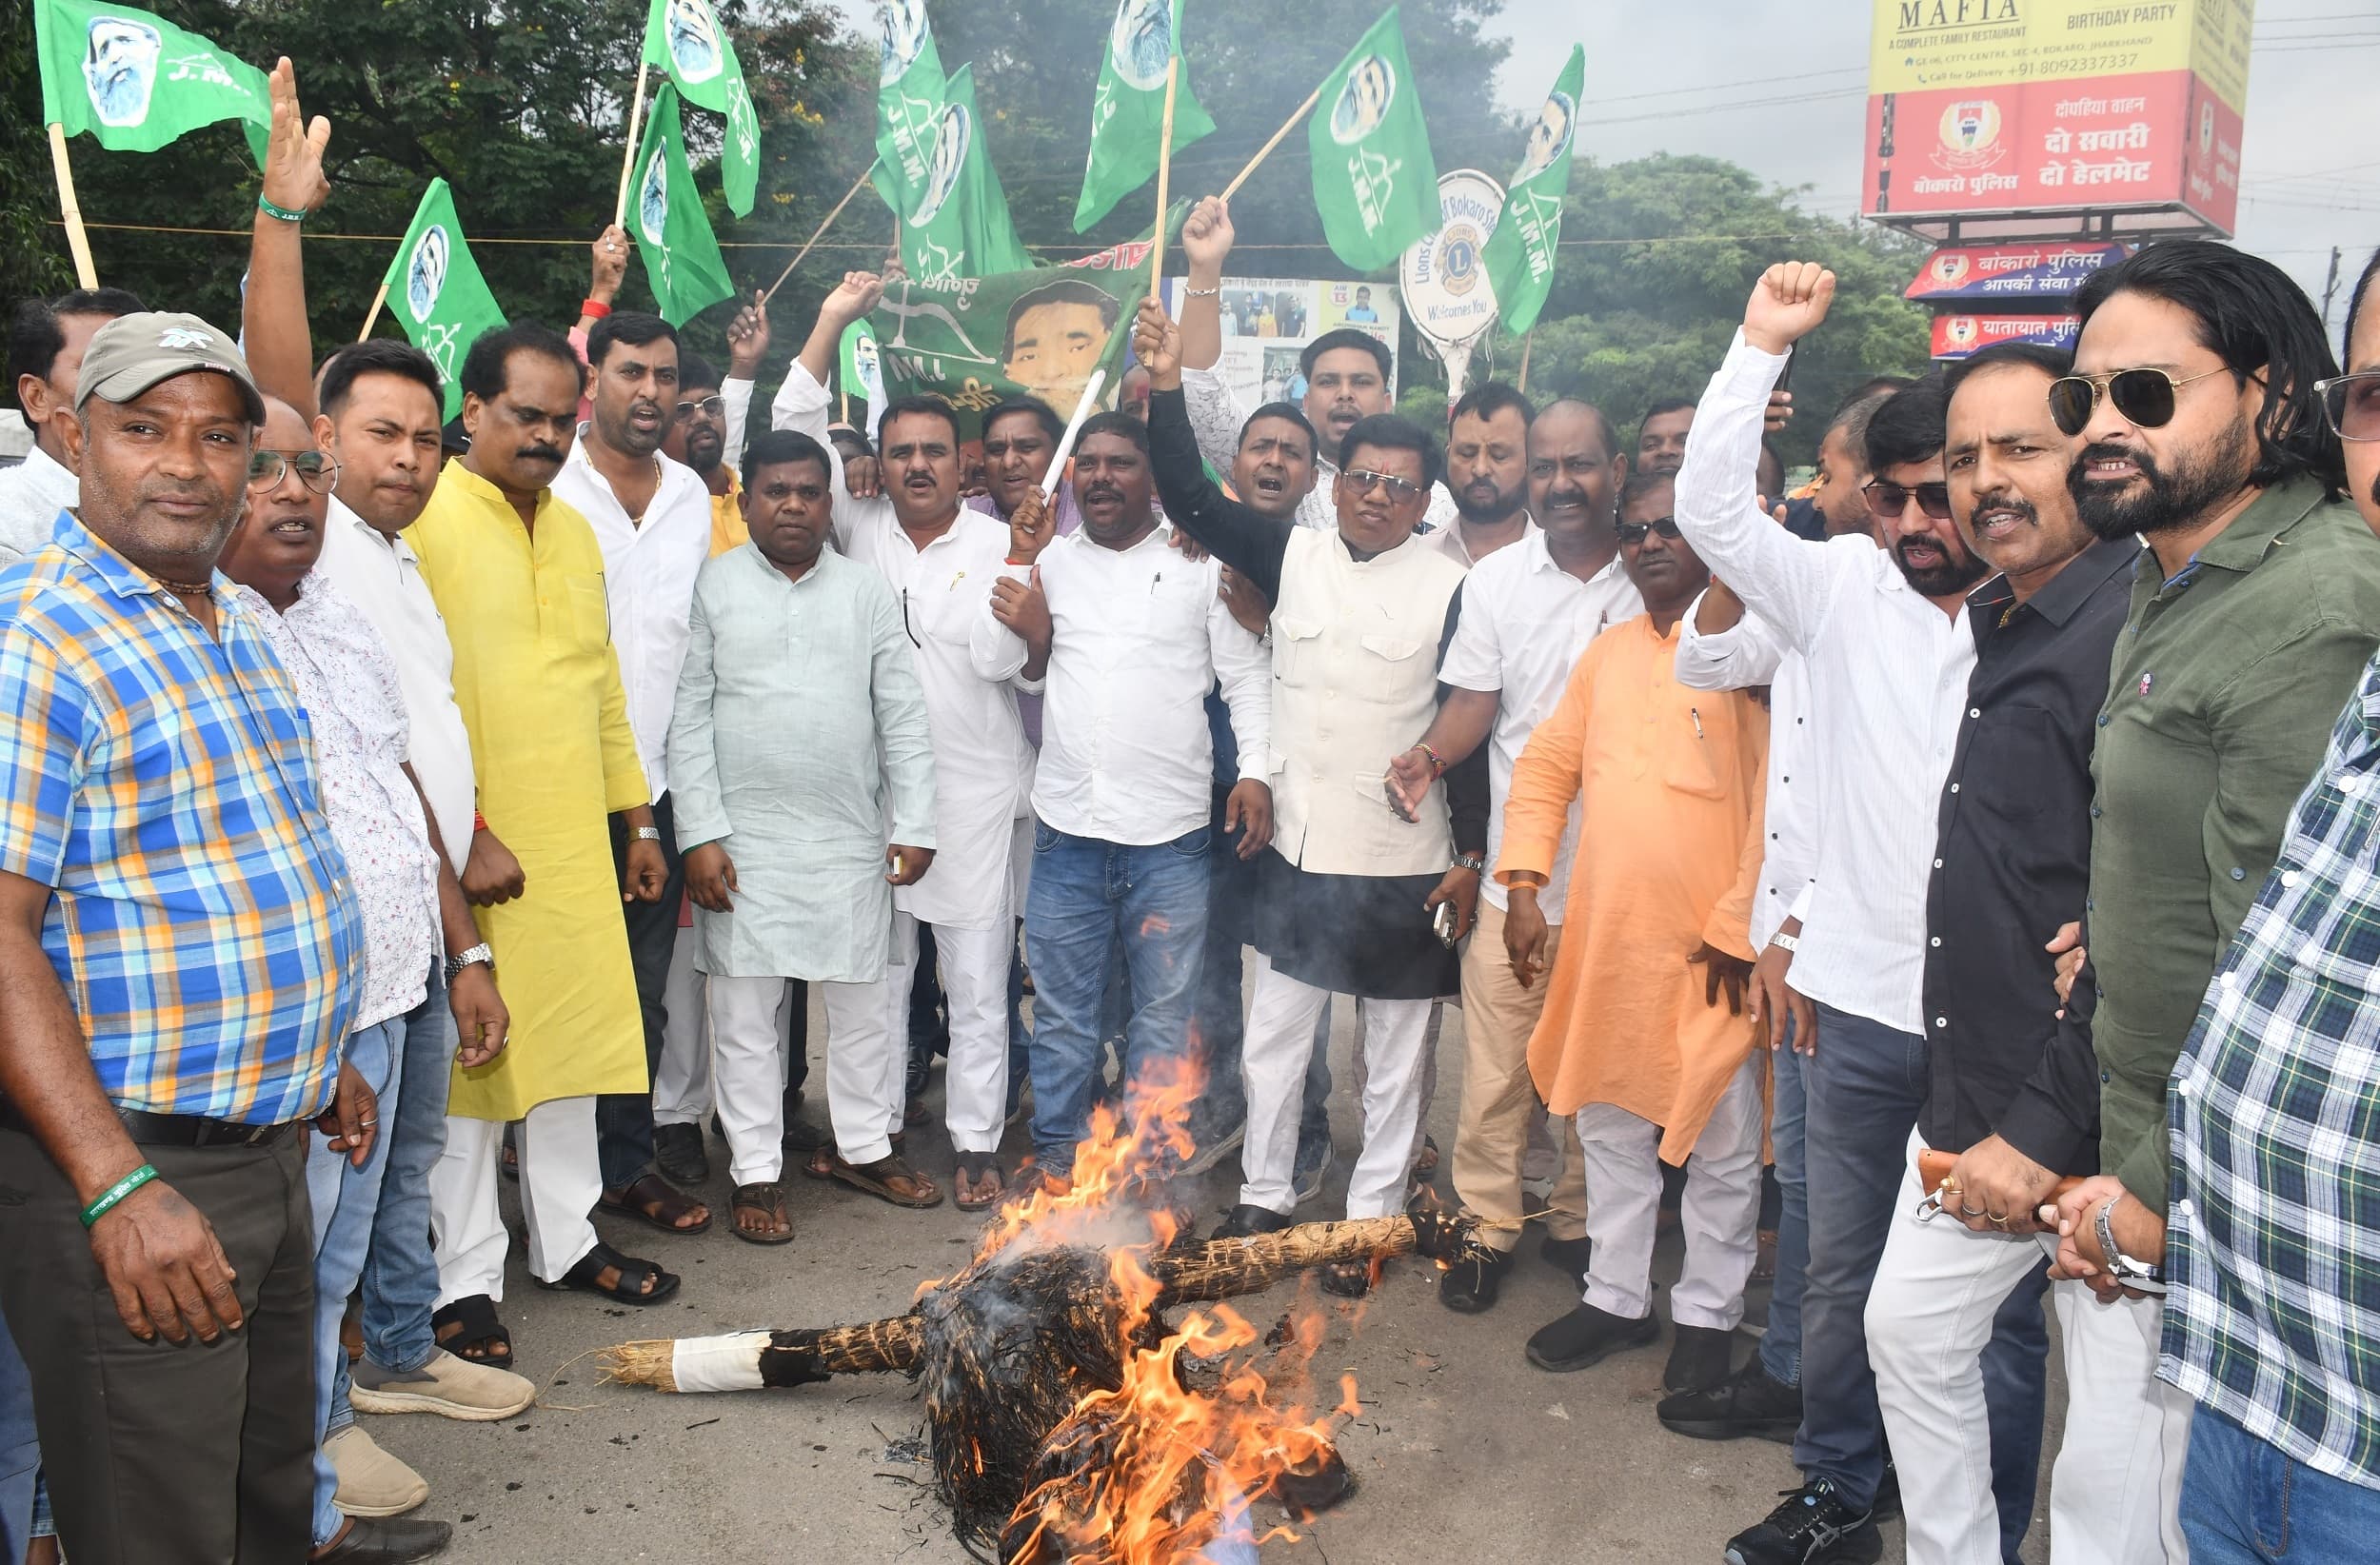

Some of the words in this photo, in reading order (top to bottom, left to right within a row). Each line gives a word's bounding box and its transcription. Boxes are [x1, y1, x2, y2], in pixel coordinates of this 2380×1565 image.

[1897, 0, 2018, 30] MAFIA
[2067, 8, 2130, 30] BIRTHDAY
[2133, 4, 2177, 23] PARTY
[1889, 40, 1895, 50] A
[1896, 36, 1938, 50] COMPLETE
[1940, 32, 1971, 46] FAMILY
[1972, 27, 2026, 42] RESTAURANT
[2044, 128, 2072, 153] दो
[2078, 122, 2152, 152] सवारी
[1913, 175, 1966, 194] बोकारो
[1969, 172, 2018, 197] पुलिस
[2039, 160, 2067, 187] दो
[2071, 156, 2152, 186] हेलमेट
[1449, 192, 1487, 225] Bokaro
[1510, 200, 1548, 284] J.M.M.
[1454, 249, 1468, 272] L
[1978, 250, 2041, 271] बोकारो
[2047, 249, 2106, 274] पुलिस
[1982, 274, 2035, 291] आपकी
[2038, 275, 2068, 291] सेवा
[1982, 320, 2047, 336] यातायात
[2053, 316, 2081, 342] पुलि
